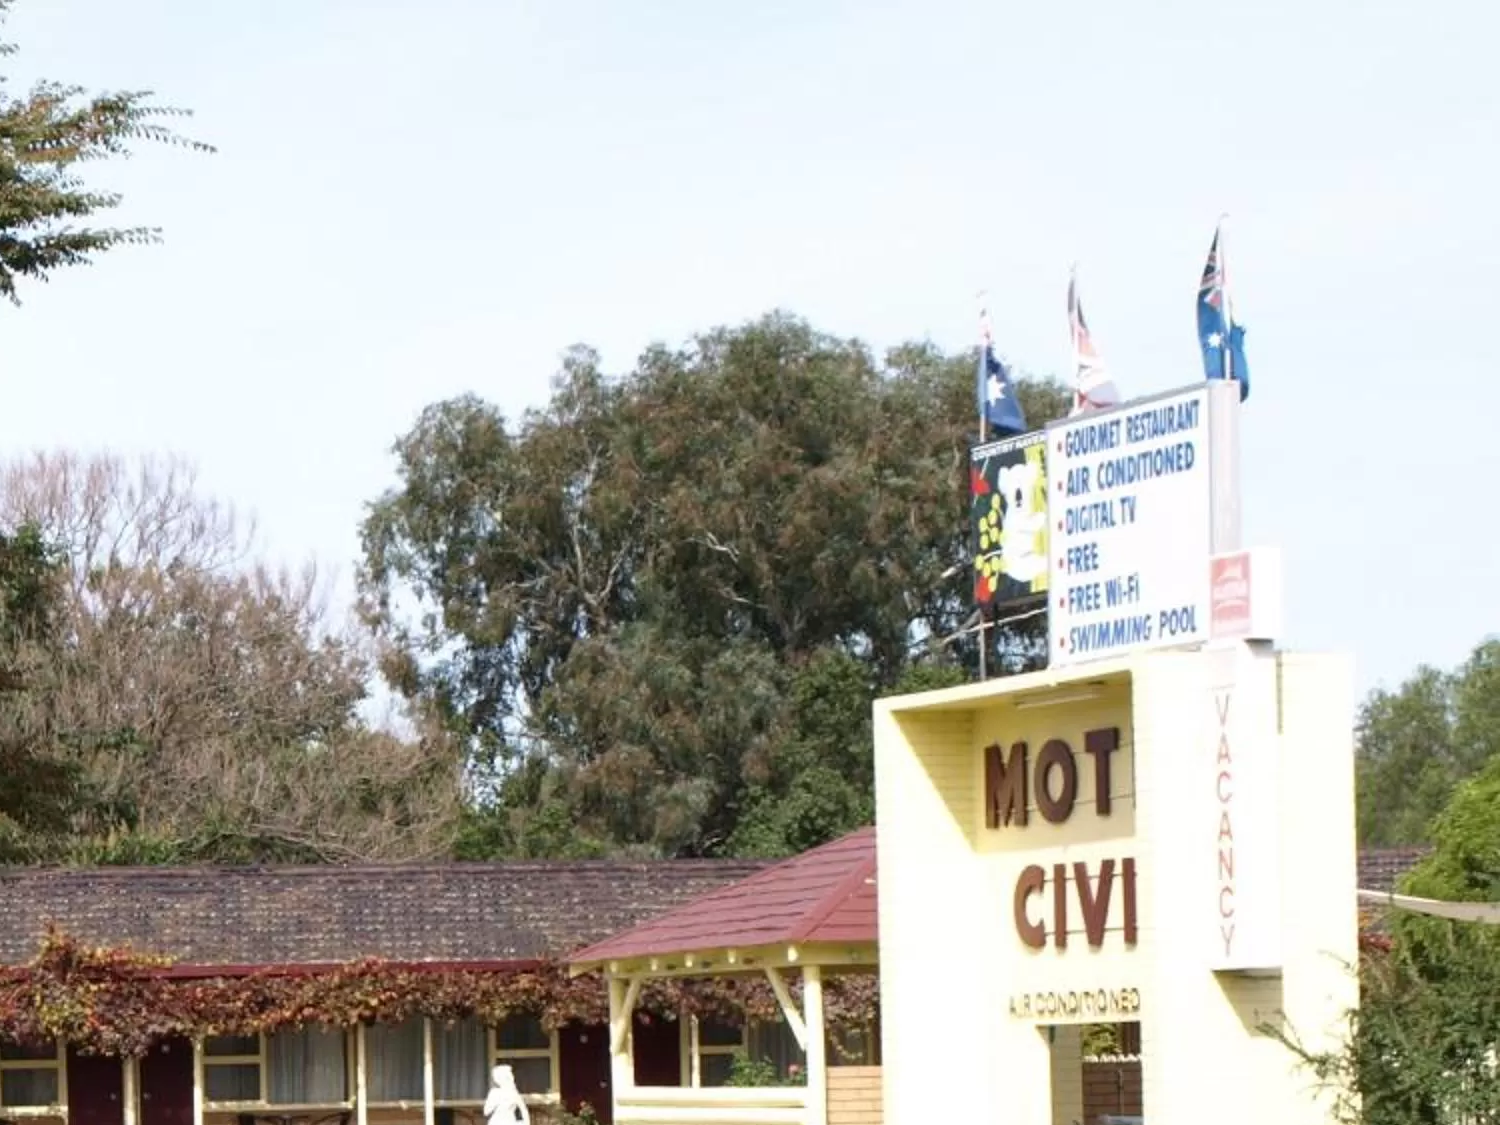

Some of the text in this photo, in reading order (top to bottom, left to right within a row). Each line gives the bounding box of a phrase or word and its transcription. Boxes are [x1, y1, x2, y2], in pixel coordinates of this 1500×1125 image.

[1065, 418, 1121, 458] GOURMET
[1125, 398, 1200, 445] RESTAURANT
[1066, 441, 1195, 498] AIR CONDITIONED
[1066, 495, 1137, 536] DIGITAL TV
[1067, 542, 1099, 575] FREE
[1068, 571, 1140, 615] FREE Wi-Fi
[1069, 604, 1197, 655] SWIMMING POOL
[1215, 693, 1235, 958] VACANCY
